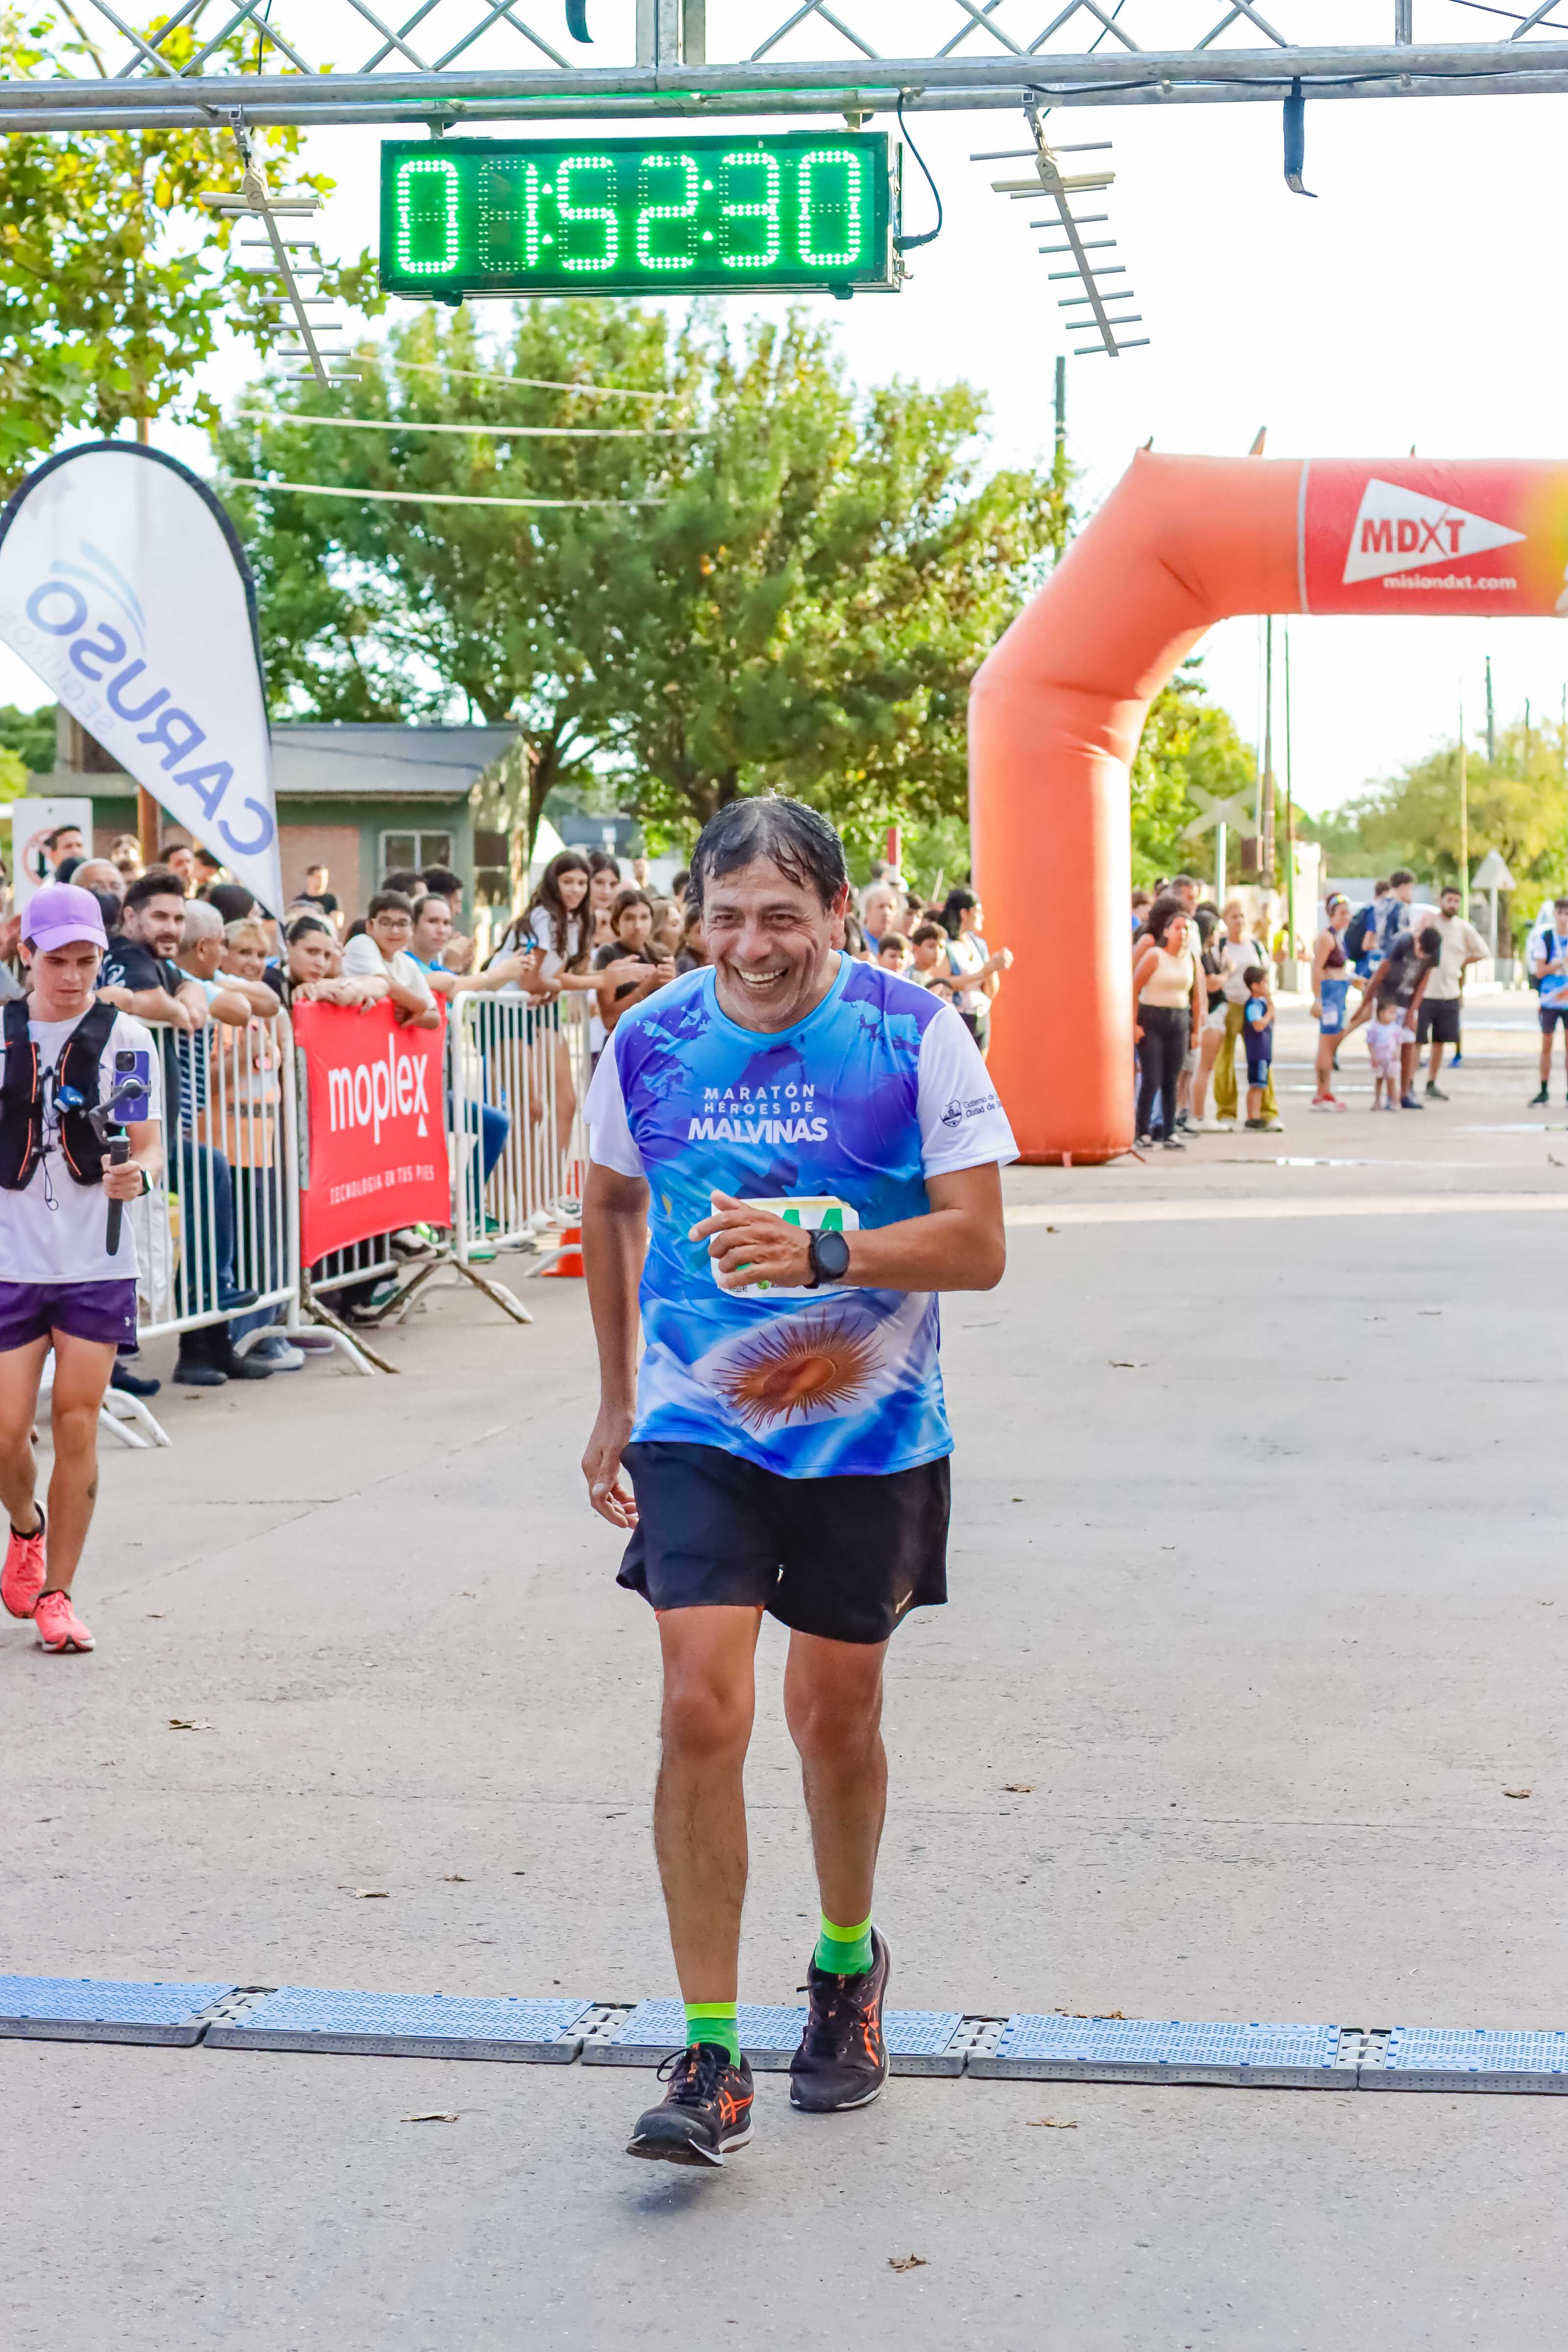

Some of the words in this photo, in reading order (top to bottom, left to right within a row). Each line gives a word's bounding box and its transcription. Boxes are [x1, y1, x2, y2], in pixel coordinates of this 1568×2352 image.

[397, 150, 861, 274] 01:52:30
[1360, 510, 1466, 558] MDXT
[327, 1032, 429, 1145] moplex
[704, 1081, 815, 1100] MARATÓN
[704, 1101, 781, 1115] HÉROES
[790, 1101, 813, 1113] DE
[687, 1117, 829, 1144] MALVINAS
[397, 1165, 414, 1183] TUS
